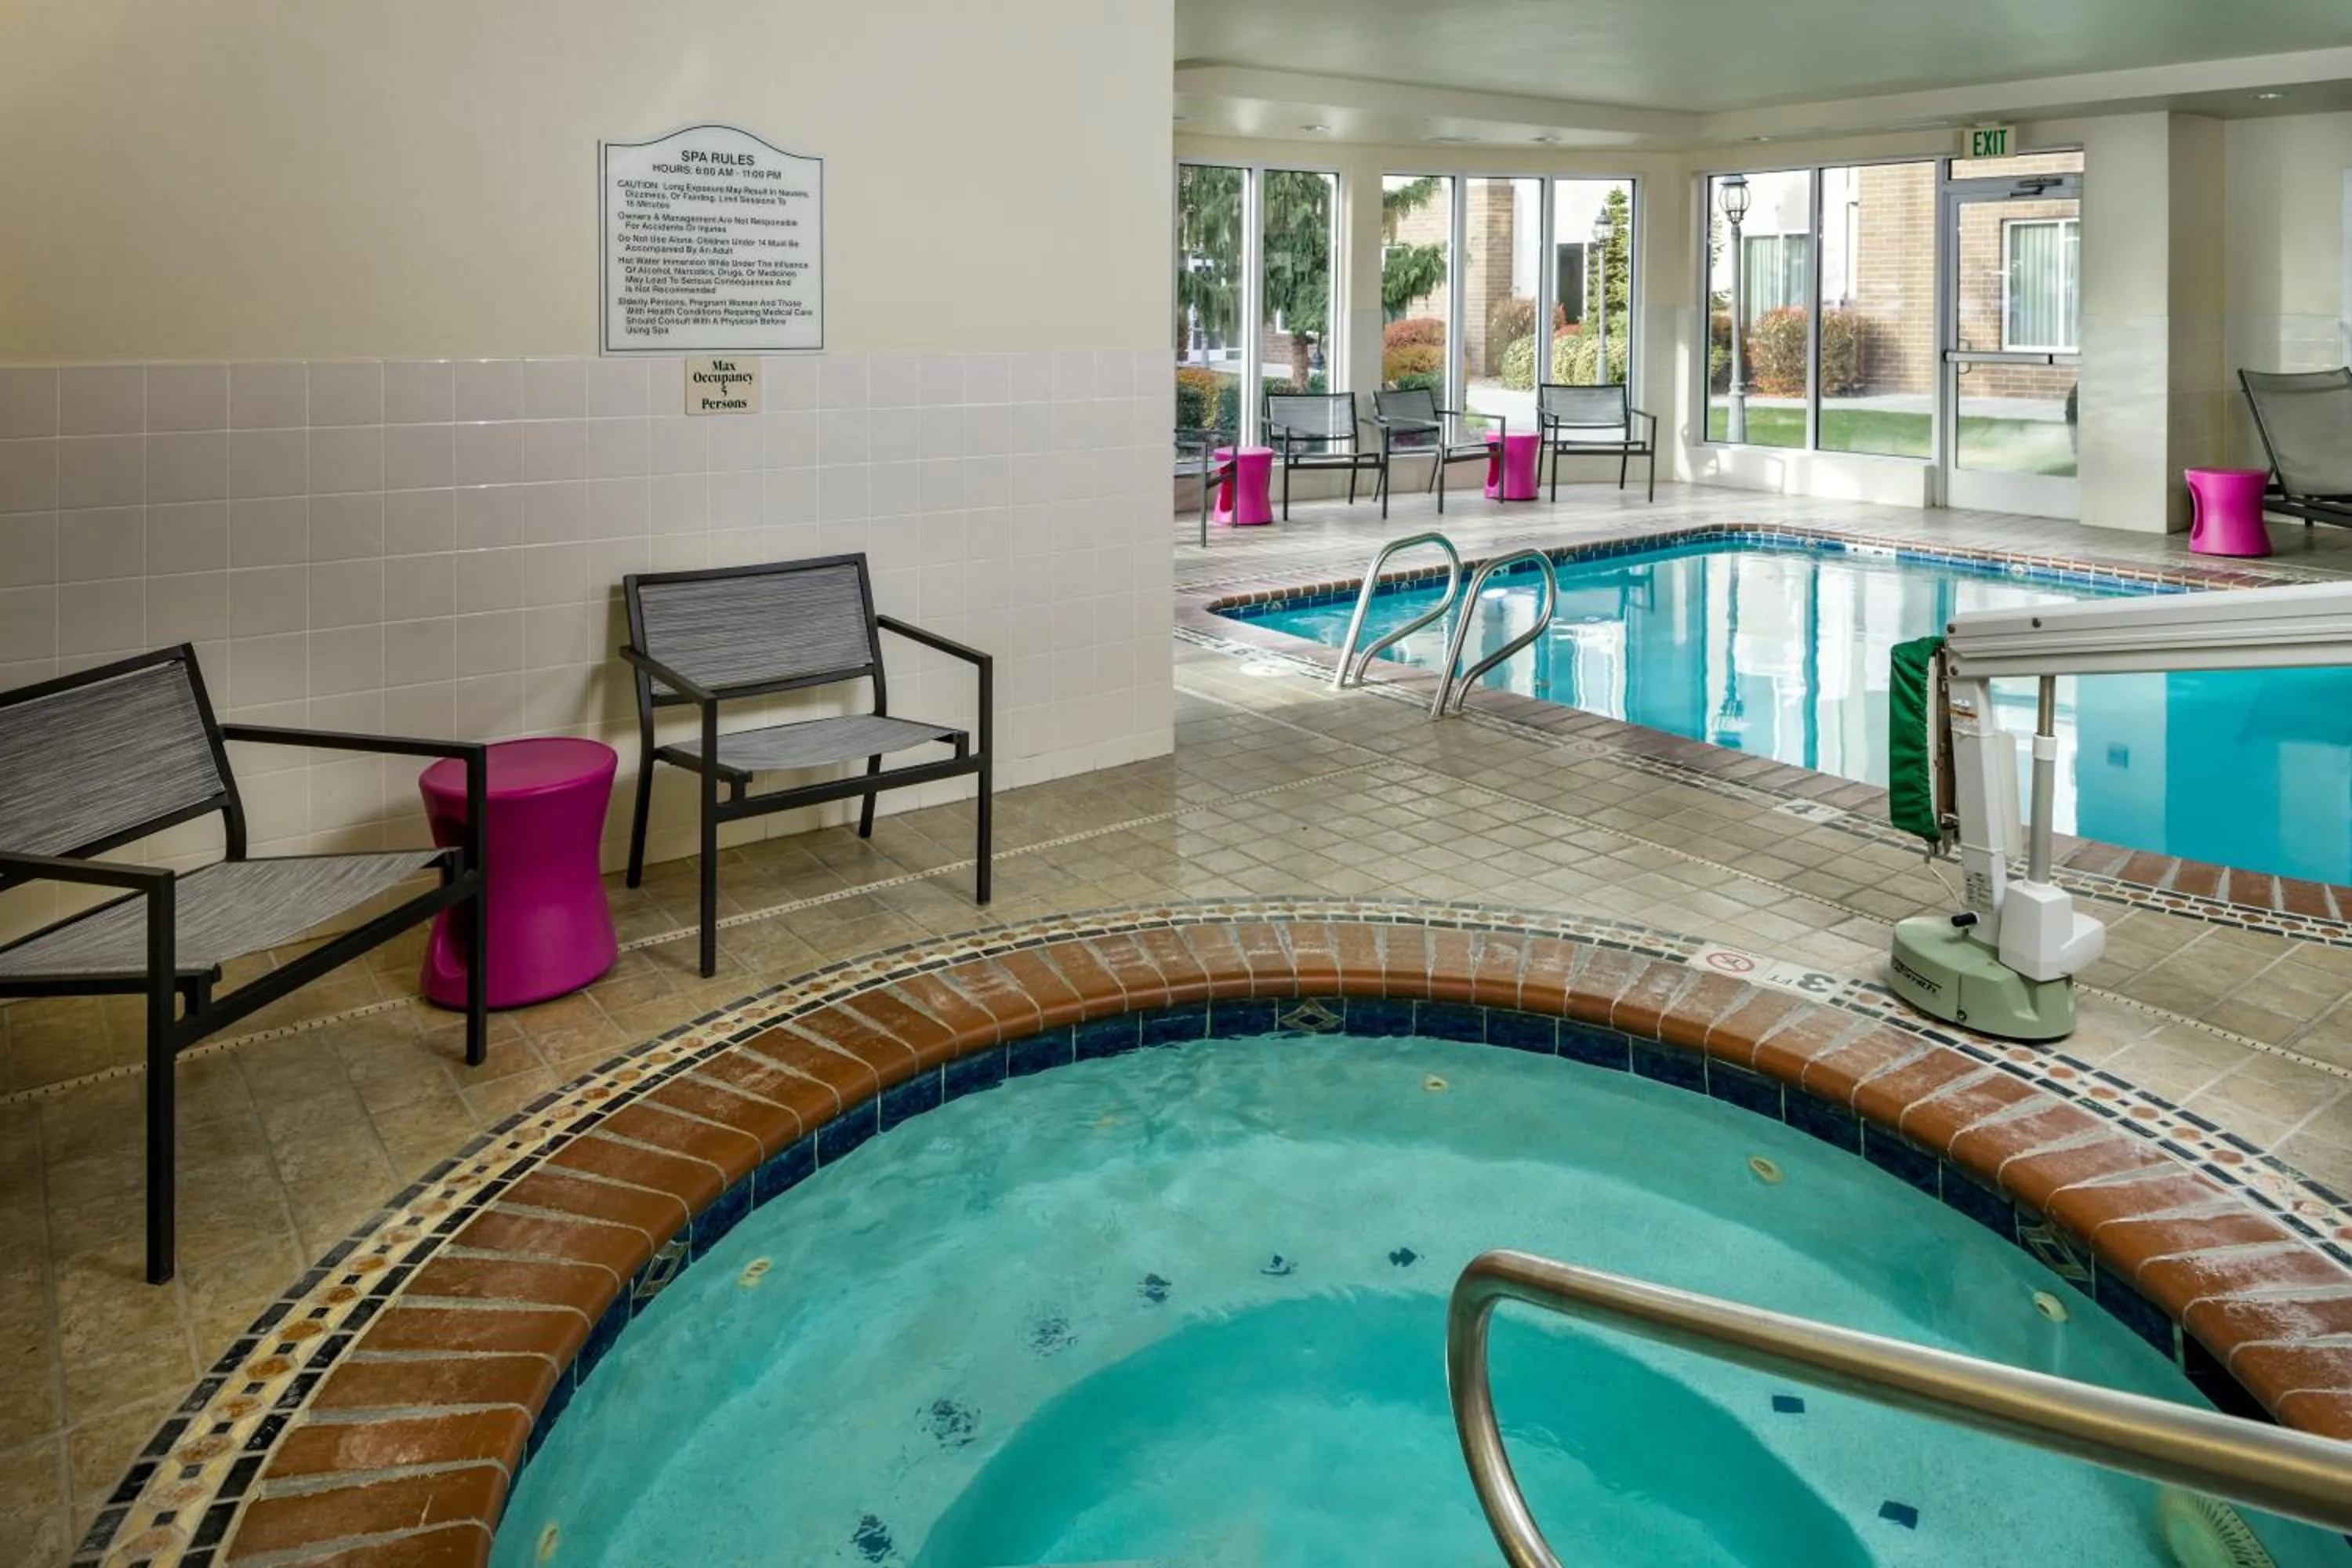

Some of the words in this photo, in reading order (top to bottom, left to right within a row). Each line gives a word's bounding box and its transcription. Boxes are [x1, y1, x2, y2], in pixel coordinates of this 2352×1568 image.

[1973, 129, 2007, 156] EXIT
[681, 150, 708, 163] SPA
[711, 153, 755, 166] RULES
[652, 163, 692, 174] HOURS:
[695, 165, 716, 176] 6:00
[718, 168, 734, 176] AM
[742, 169, 764, 178] 11:00
[767, 170, 782, 180] PM
[663, 183, 684, 192] Long
[686, 183, 725, 193] Exposure
[726, 187, 742, 195] May
[637, 201, 670, 209] Minutes
[739, 196, 775, 205] Sessions
[777, 197, 786, 205] To
[617, 211, 652, 220] Owners
[662, 213, 717, 223] Management
[642, 222, 684, 231] Accidents
[697, 225, 727, 234] Injuries
[618, 234, 631, 242] Do
[626, 245, 684, 253] Accompanied
[686, 246, 697, 255] By
[714, 278, 774, 287] Consequences
[618, 297, 648, 307] Elderly
[689, 298, 728, 307] Pregnant
[724, 308, 760, 317] Requiring
[626, 316, 656, 325] Should
[658, 316, 690, 325] Consult
[720, 318, 758, 326] Physician
[626, 326, 649, 336] Using
[652, 325, 669, 334] Spa
[713, 360, 737, 371] Max
[693, 372, 753, 387] Occupancy
[702, 397, 747, 409] Persons
[1797, 972, 1837, 993] 3
